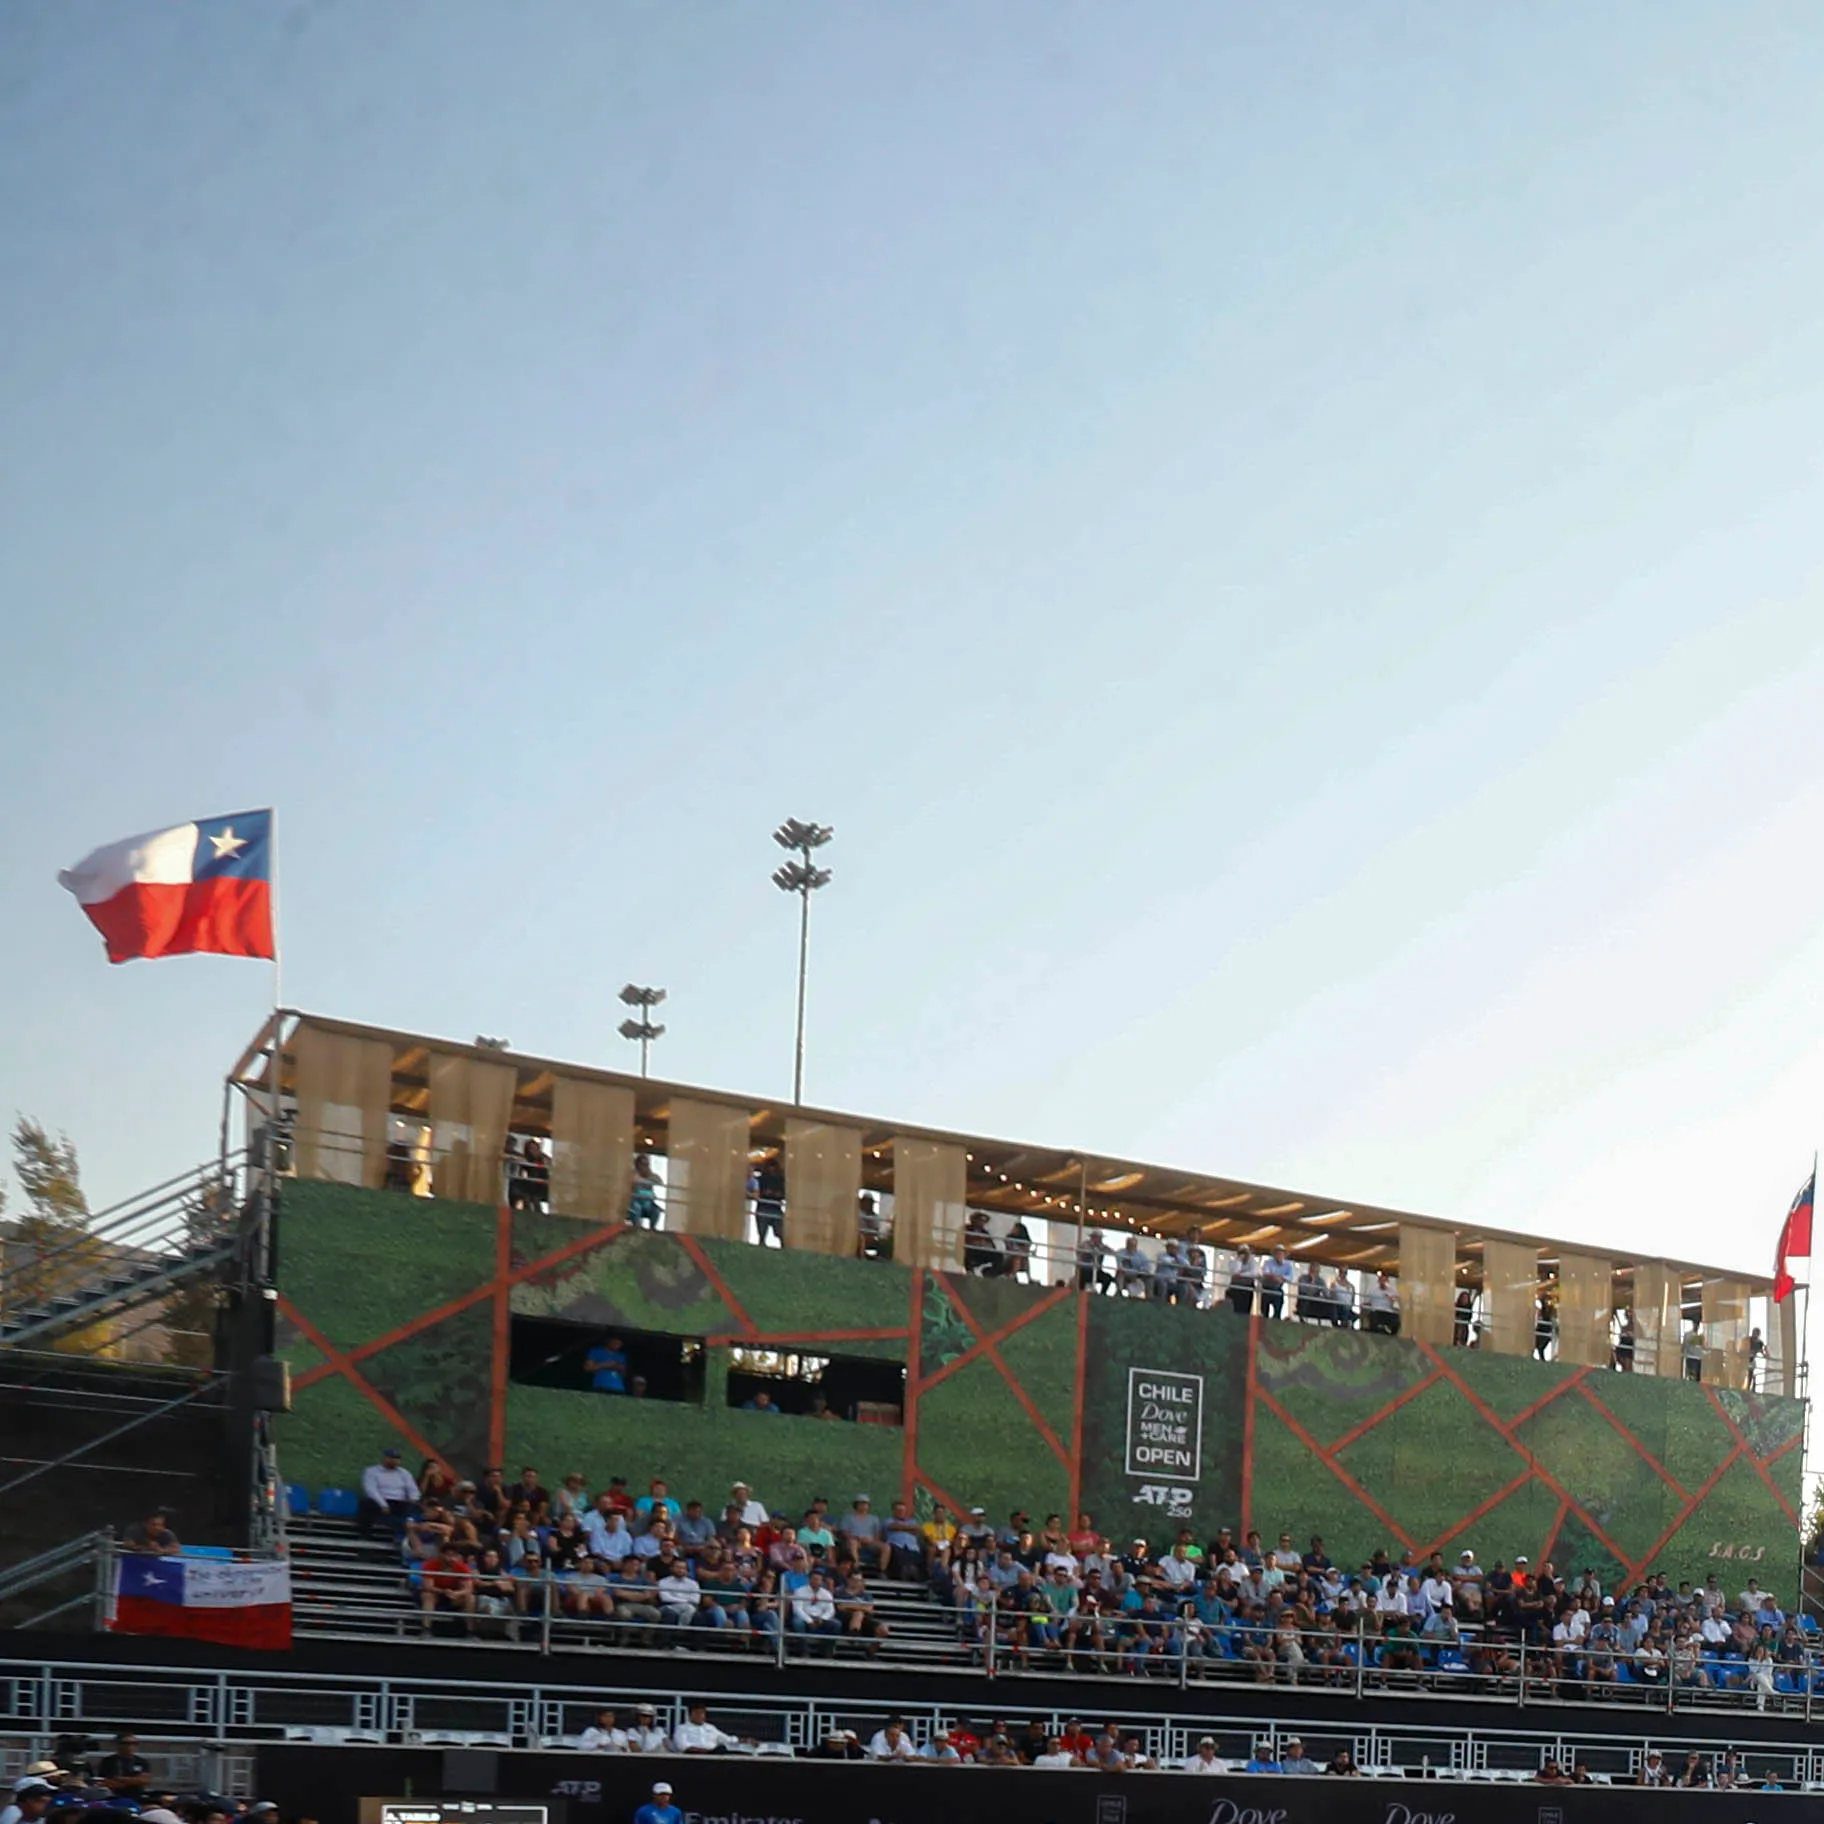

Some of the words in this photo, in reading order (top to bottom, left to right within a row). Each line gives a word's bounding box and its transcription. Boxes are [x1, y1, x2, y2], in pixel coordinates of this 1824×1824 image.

[1138, 1383, 1193, 1404] CHILE
[1140, 1401, 1188, 1423] Dove
[1140, 1422, 1172, 1434] MEN
[1136, 1446, 1191, 1467] OPEN
[1132, 1484, 1193, 1505] ATP
[1166, 1503, 1193, 1518] 250
